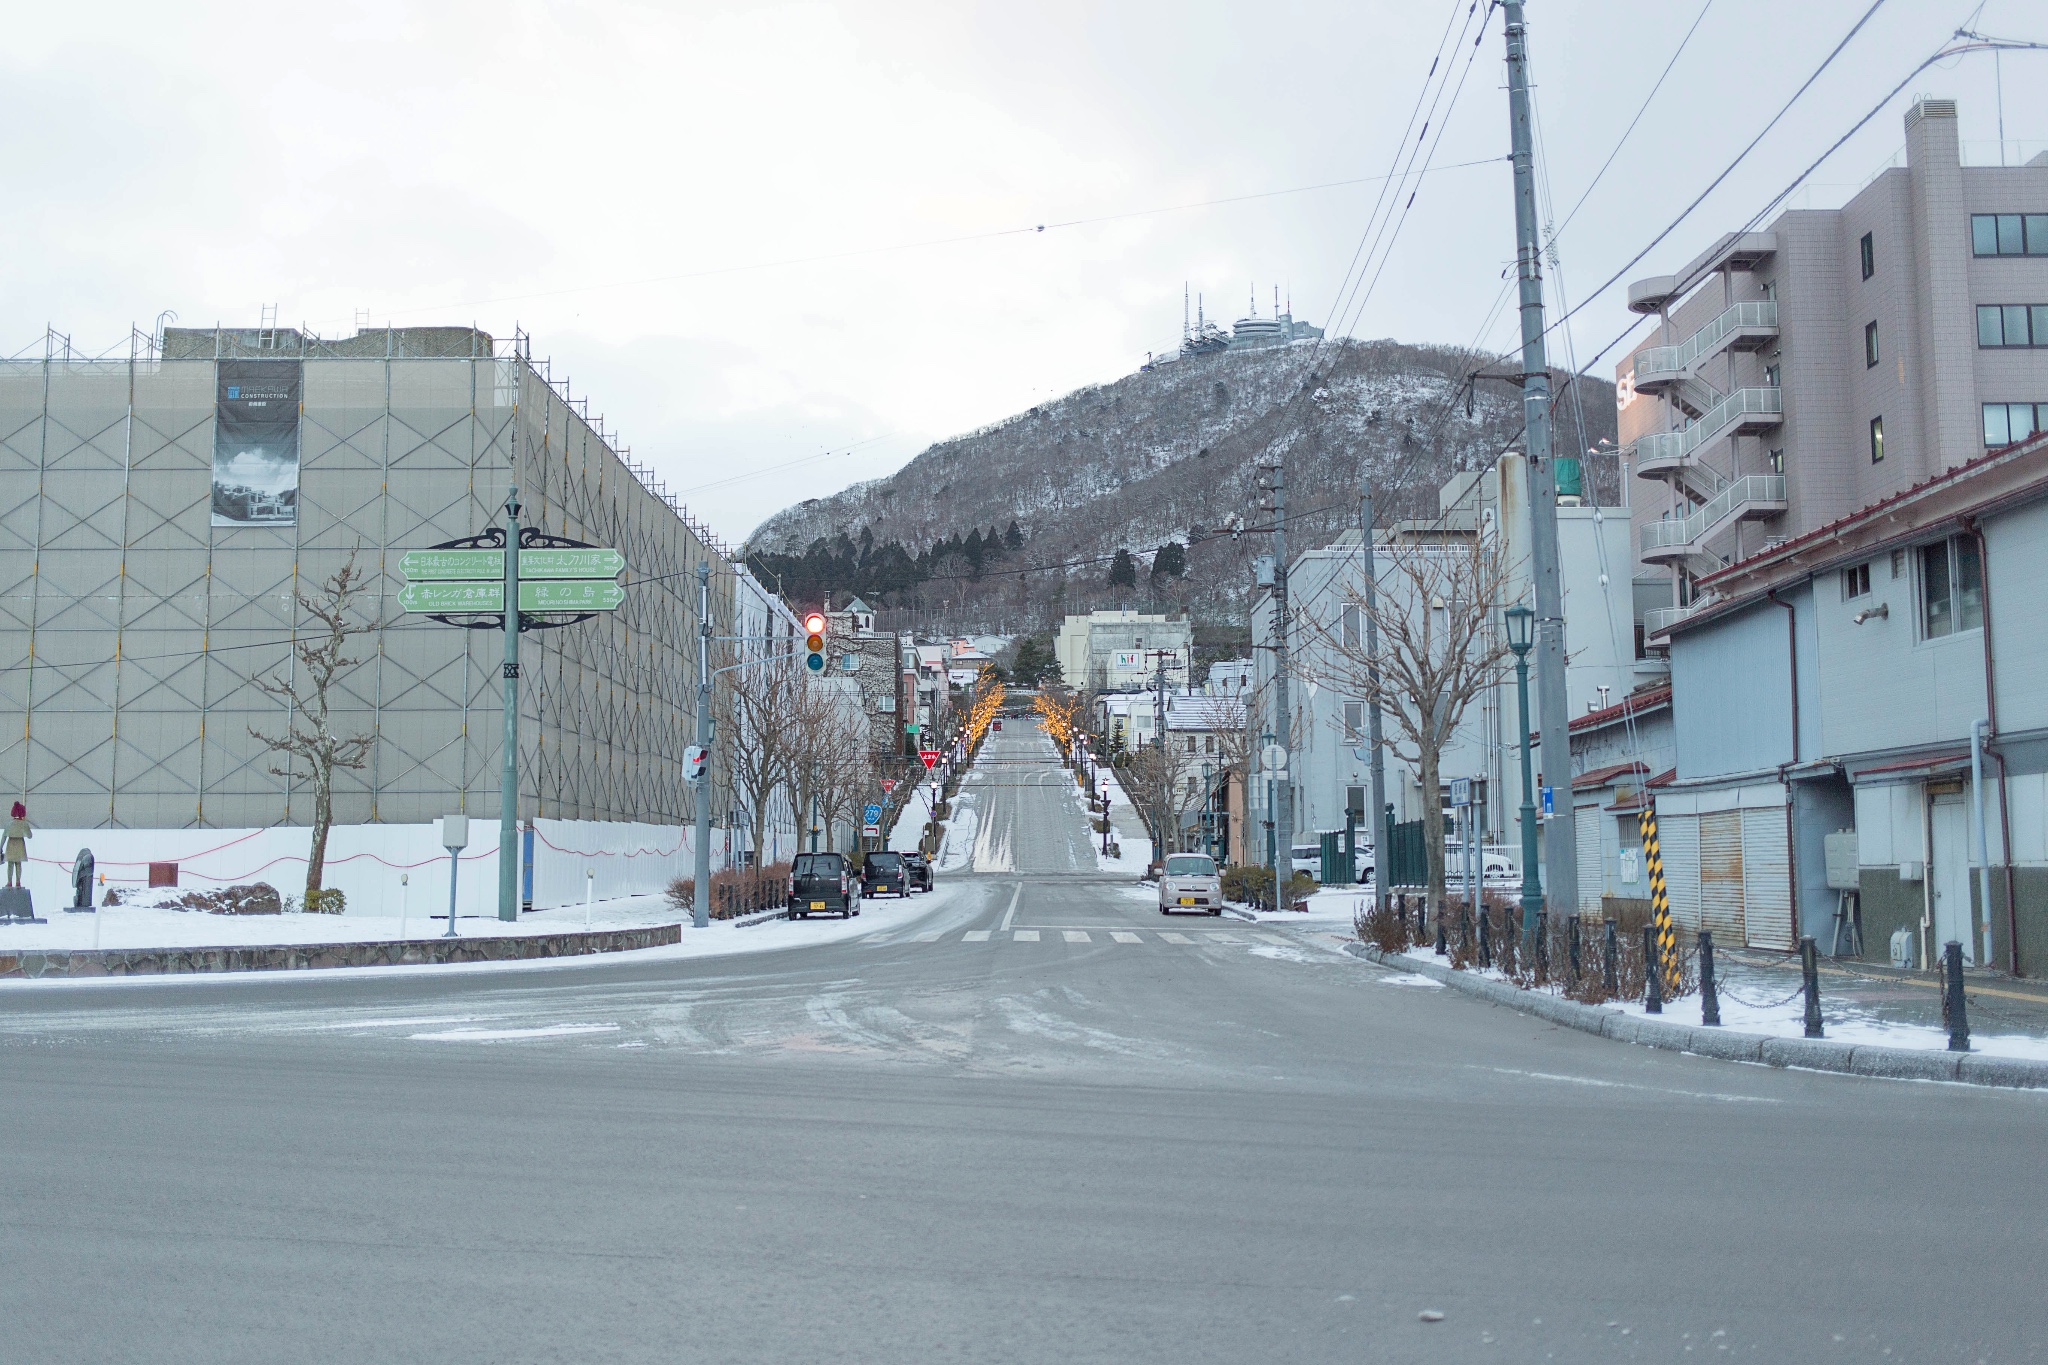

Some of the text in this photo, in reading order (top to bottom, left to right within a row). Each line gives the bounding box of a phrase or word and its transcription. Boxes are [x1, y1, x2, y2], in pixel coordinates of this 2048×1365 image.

[421, 587, 501, 599] 赤レンガ倉庫群
[865, 809, 879, 817] 279
